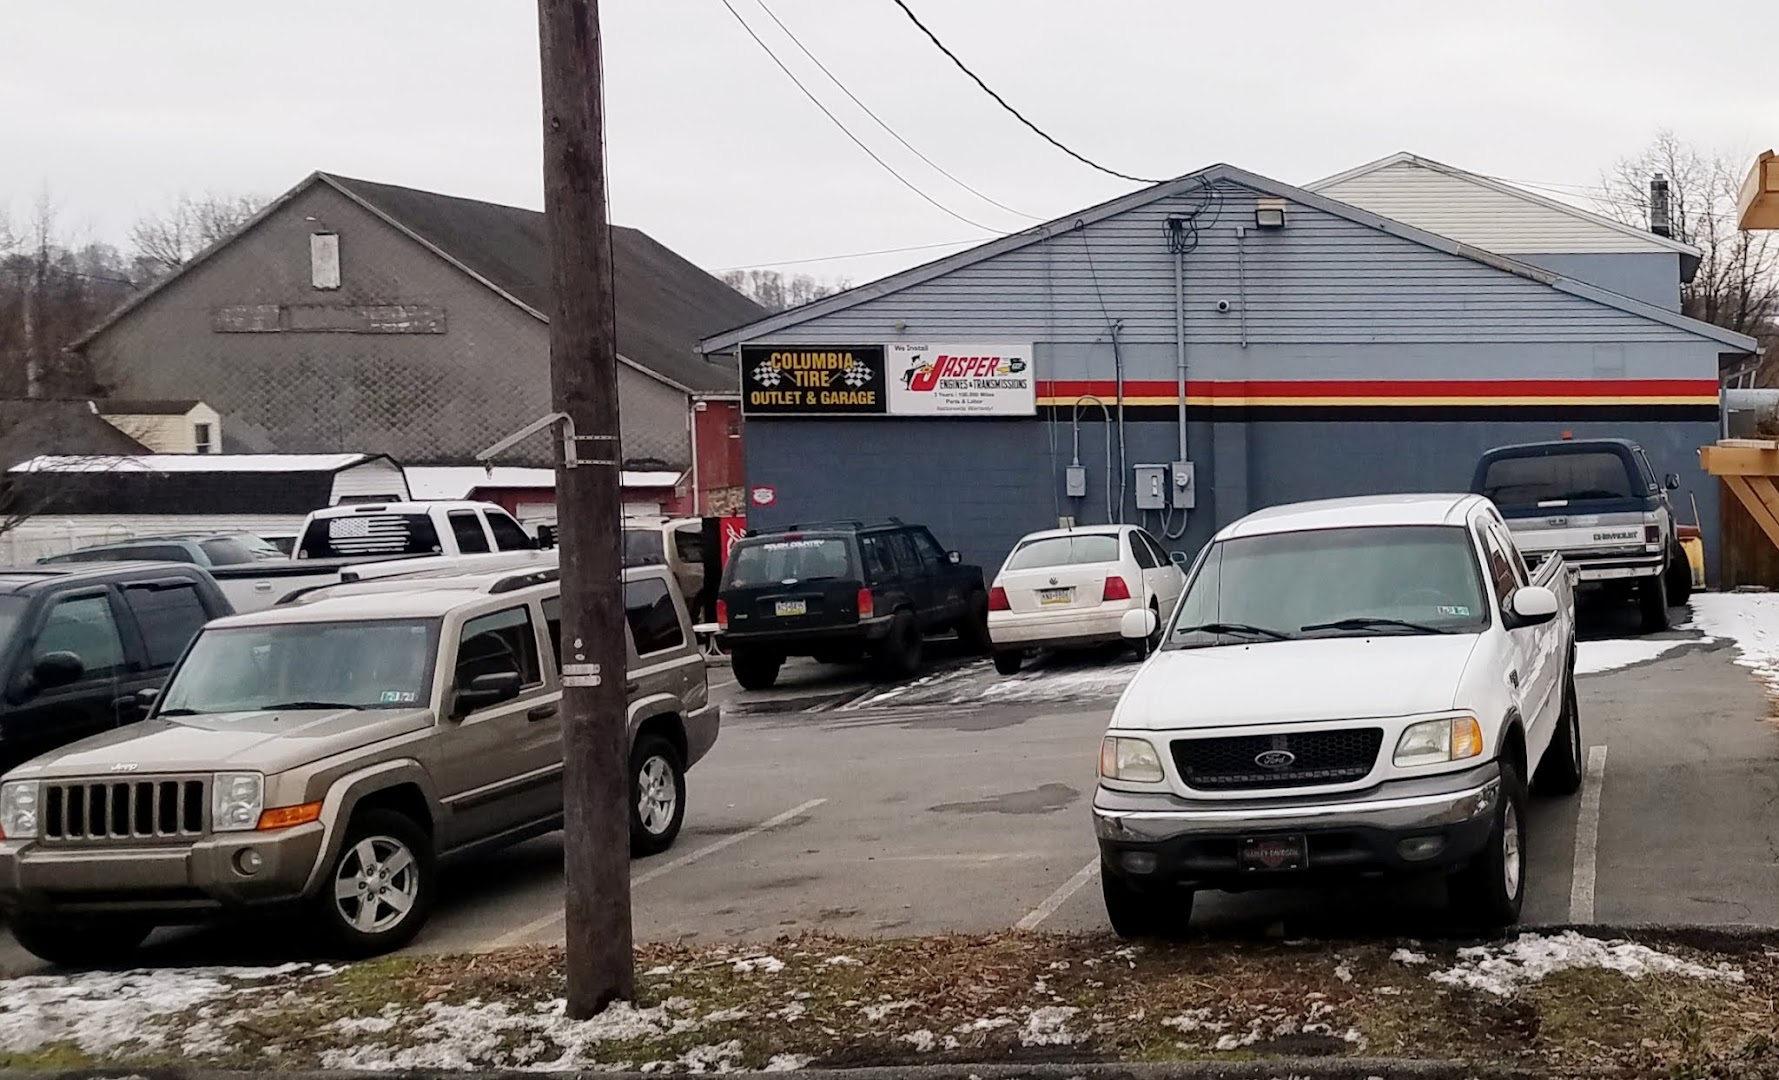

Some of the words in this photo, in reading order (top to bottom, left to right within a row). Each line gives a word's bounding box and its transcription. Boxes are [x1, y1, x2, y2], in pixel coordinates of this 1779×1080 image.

[770, 352, 854, 370] COLUMBIA
[794, 370, 830, 387] TIRE
[911, 355, 1000, 391] JASPER
[940, 379, 968, 389] ENGINES
[973, 379, 1027, 389] TRANSMISSIONS
[750, 391, 802, 405] OUTLET
[806, 391, 816, 405] &
[820, 391, 876, 405] GARAGE
[1593, 531, 1638, 541] CHEVROLET
[1264, 753, 1285, 764] Ford
[111, 763, 138, 771] Jeep
